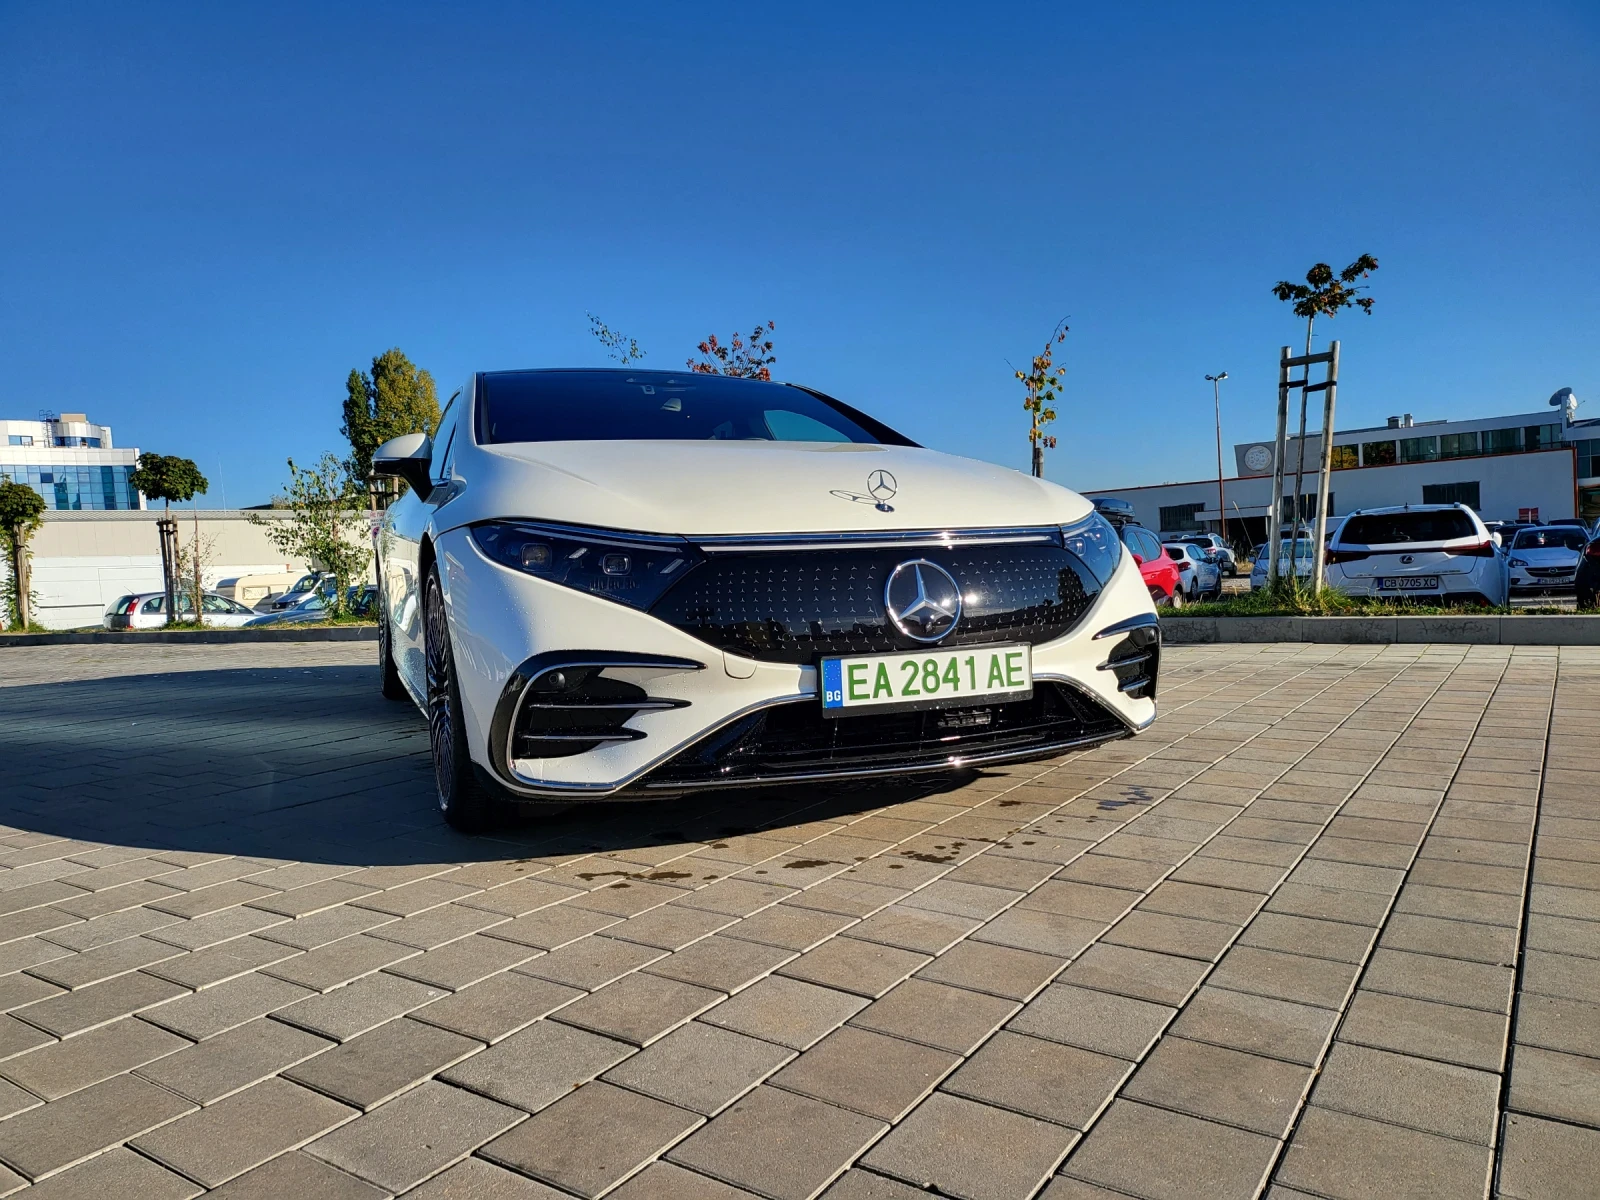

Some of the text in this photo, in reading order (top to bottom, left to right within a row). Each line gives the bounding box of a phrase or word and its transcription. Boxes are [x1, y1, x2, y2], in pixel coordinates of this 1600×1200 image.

[1384, 578, 1436, 588] CB 0705 XC
[847, 652, 1024, 700] EA 2841 AE
[826, 690, 841, 702] BG
